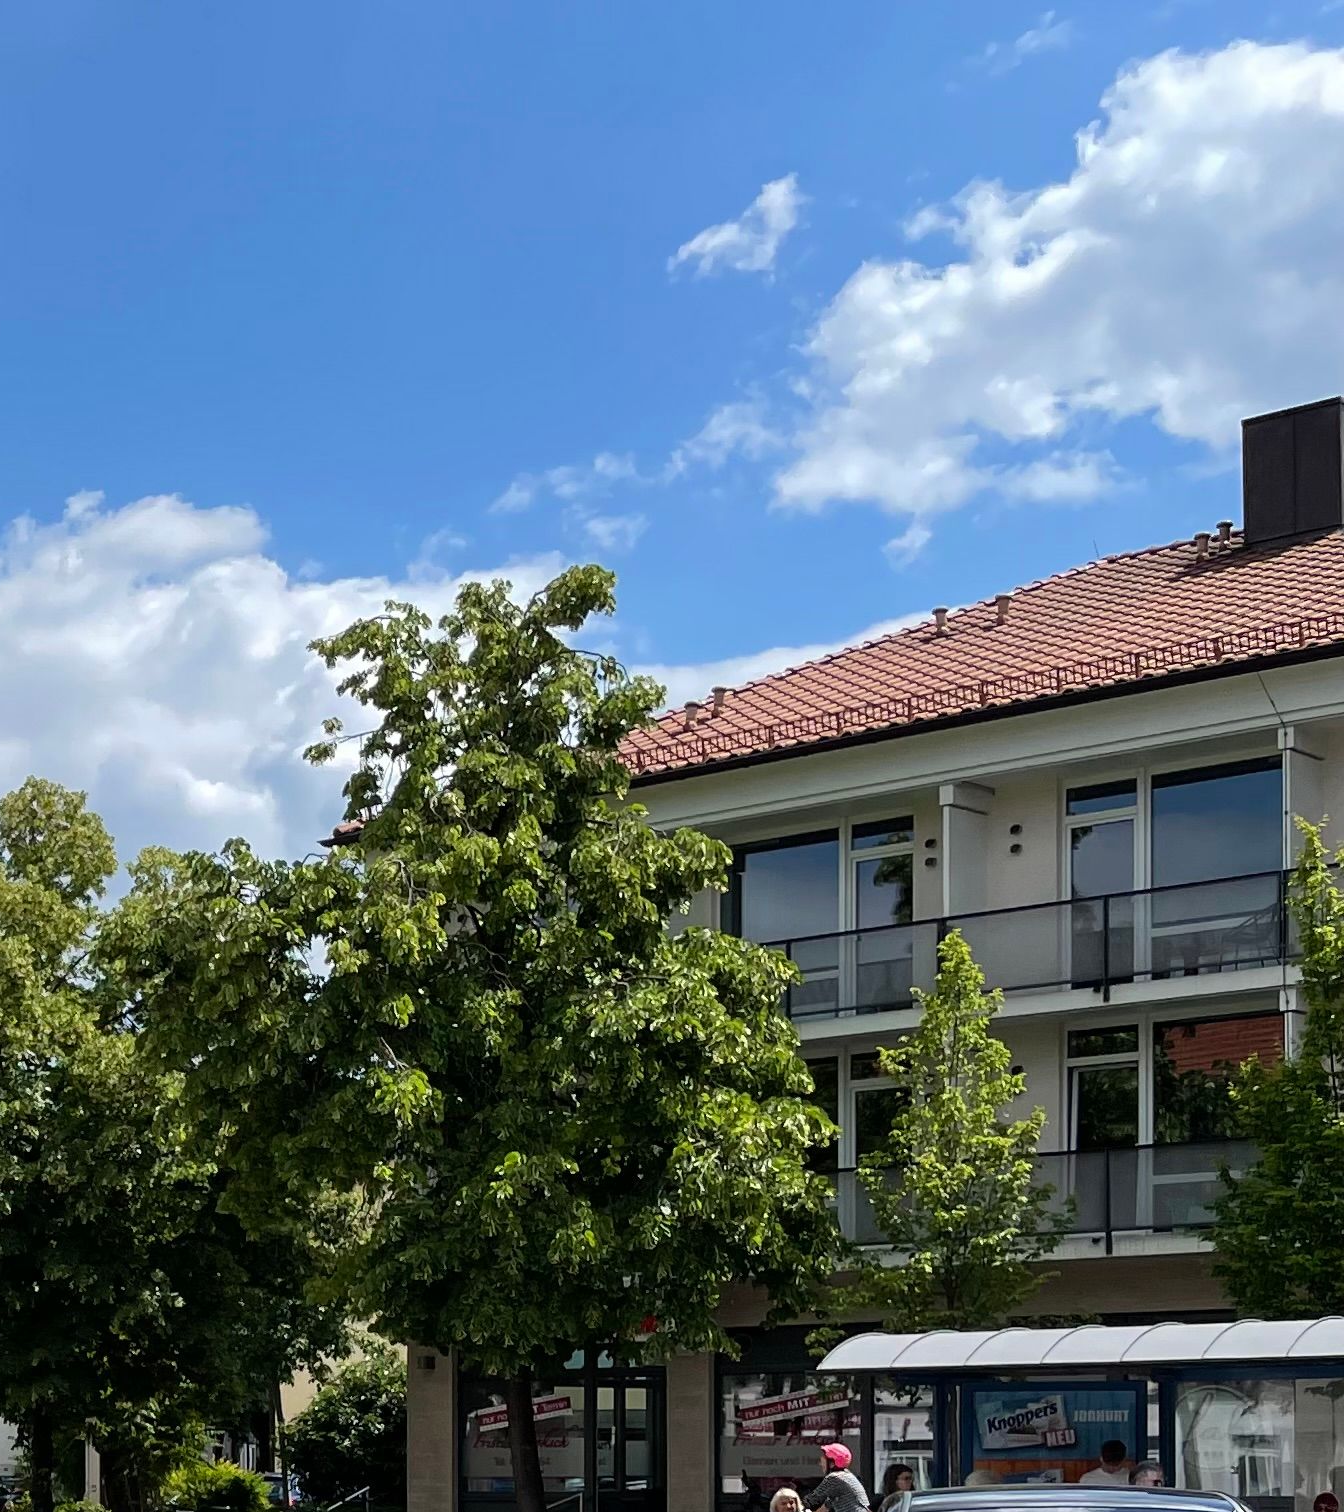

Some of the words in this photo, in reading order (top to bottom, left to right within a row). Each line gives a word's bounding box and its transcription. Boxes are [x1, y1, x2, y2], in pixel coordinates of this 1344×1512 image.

[745, 1409, 760, 1420] nur
[761, 1404, 785, 1417] noch
[786, 1397, 810, 1411] MIT
[986, 1402, 1058, 1434] Knoppers
[1046, 1429, 1075, 1447] NEU
